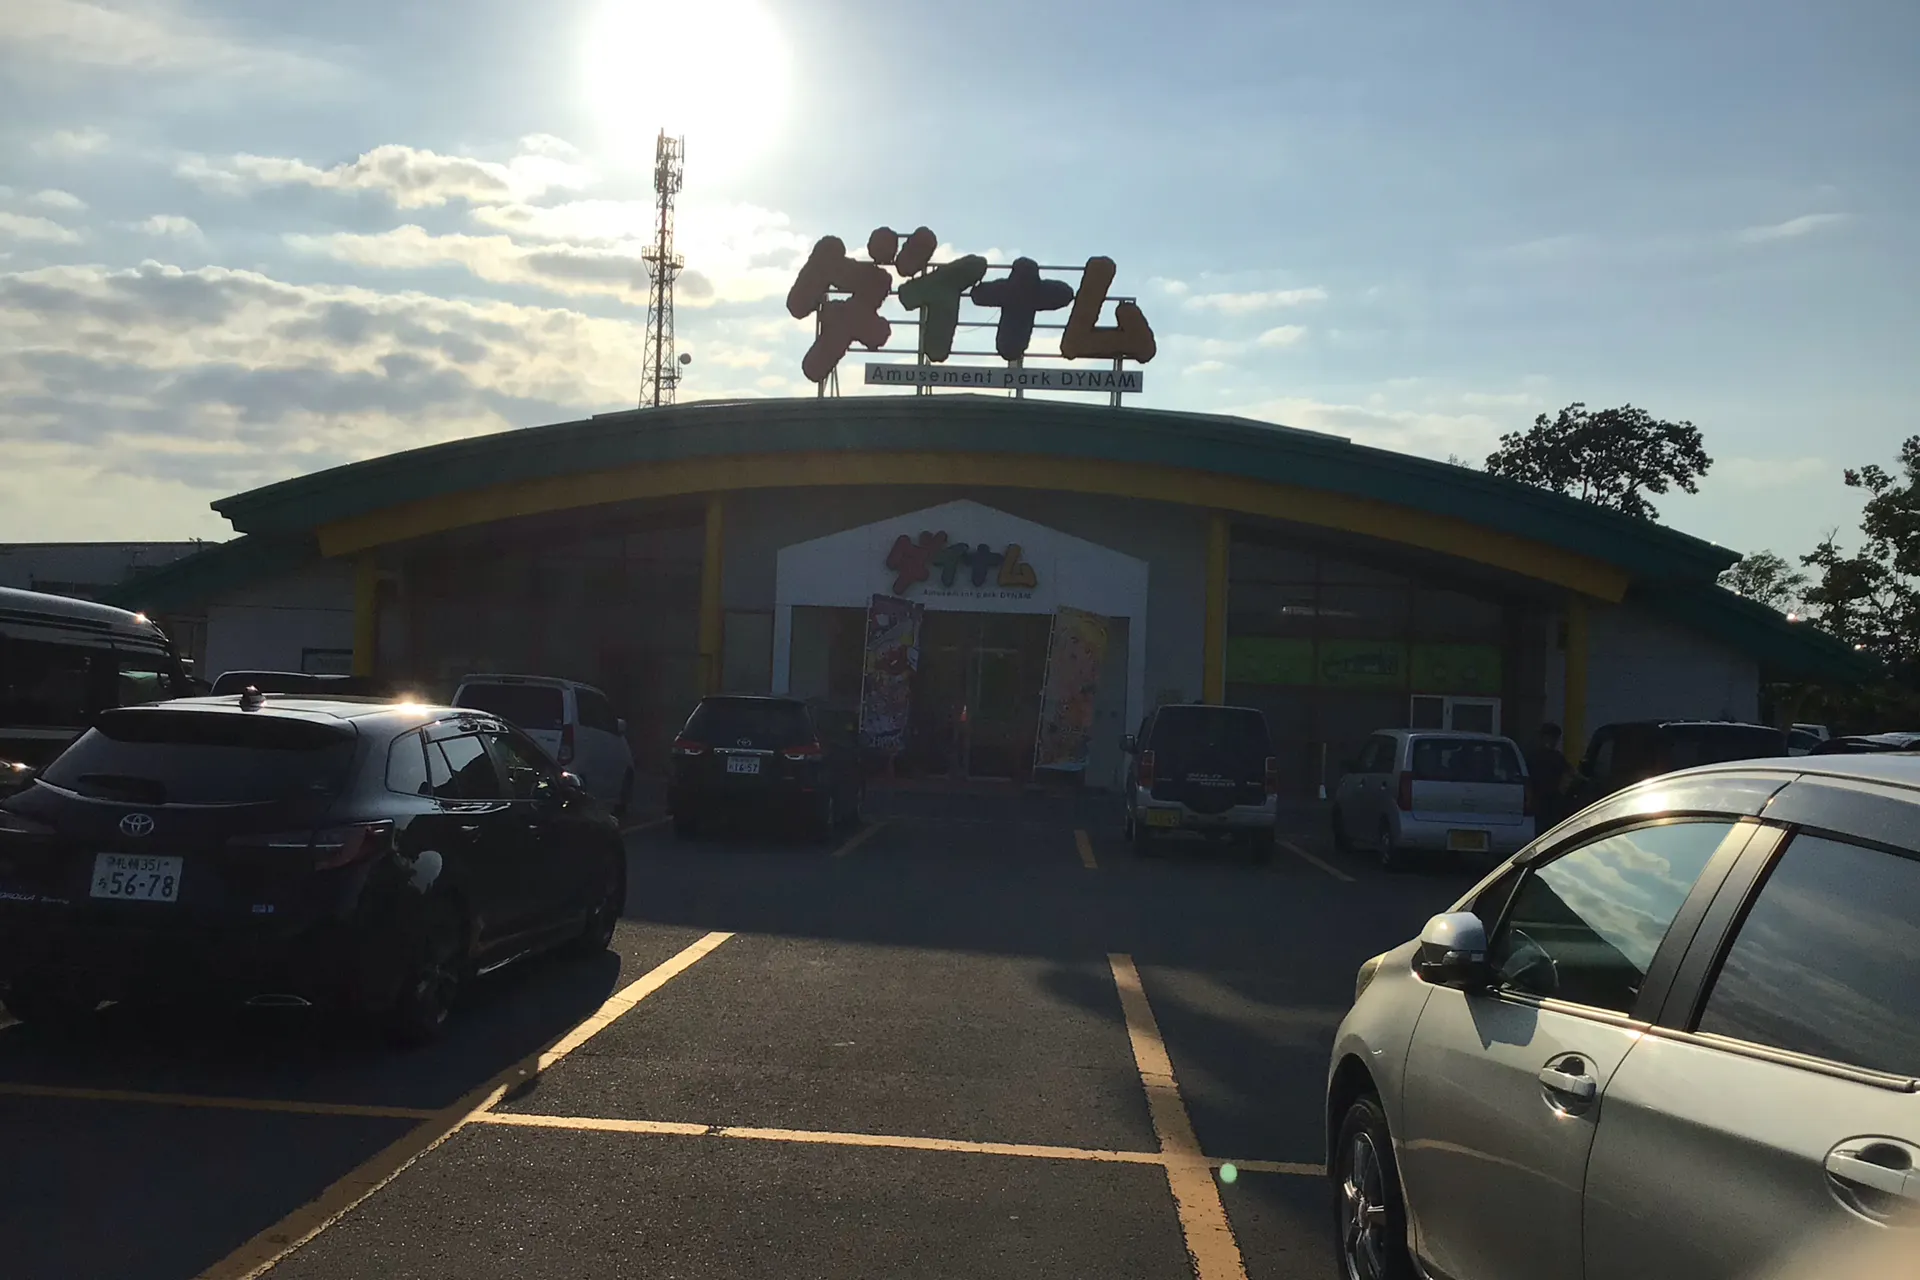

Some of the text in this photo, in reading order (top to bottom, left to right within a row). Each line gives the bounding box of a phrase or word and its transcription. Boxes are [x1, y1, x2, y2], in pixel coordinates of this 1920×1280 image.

[786, 226, 1156, 382] ダイナム
[872, 365, 1136, 389] Amusement park DYNAM
[886, 530, 1038, 595] ダイナム
[110, 871, 174, 897] 56-78
